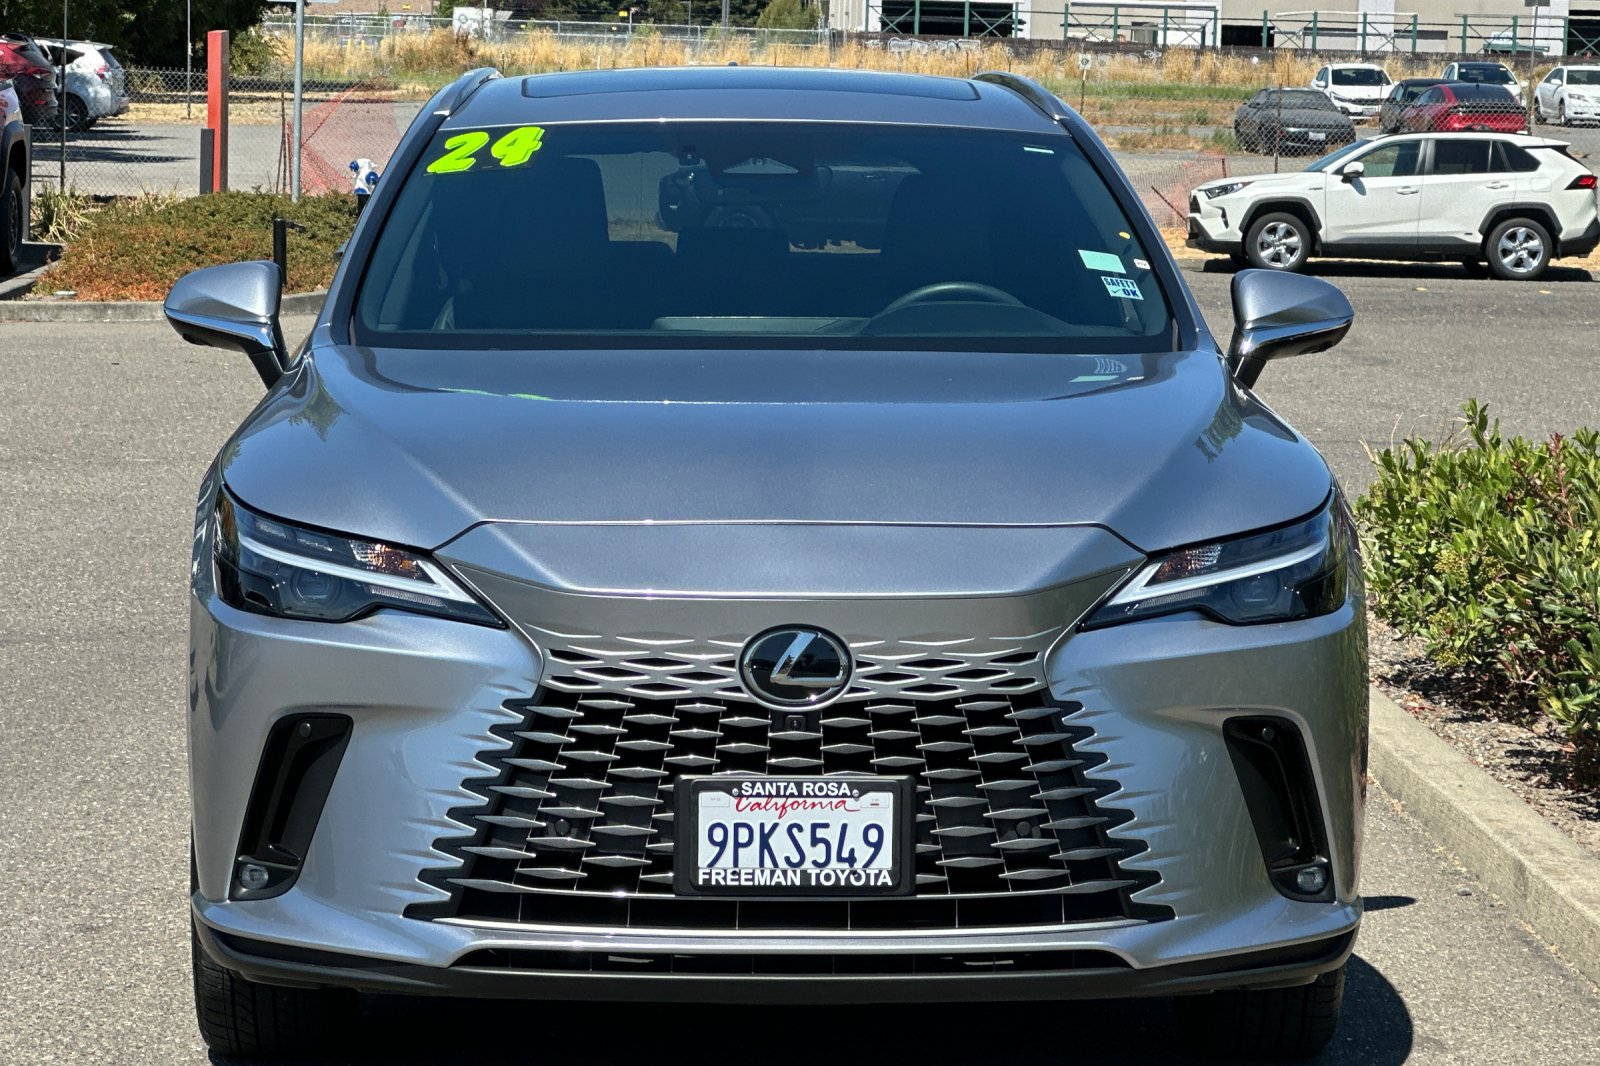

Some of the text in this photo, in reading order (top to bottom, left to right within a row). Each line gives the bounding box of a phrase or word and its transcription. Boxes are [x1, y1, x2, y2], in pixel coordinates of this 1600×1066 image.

[427, 127, 545, 172] 24
[1103, 278, 1136, 289] SAFETY
[1122, 289, 1140, 298] OK
[741, 782, 851, 796] SANTA ROSA
[735, 796, 861, 819] California
[707, 822, 885, 868] 9PKS549
[698, 868, 893, 886] FREEMAN TOYOTA
